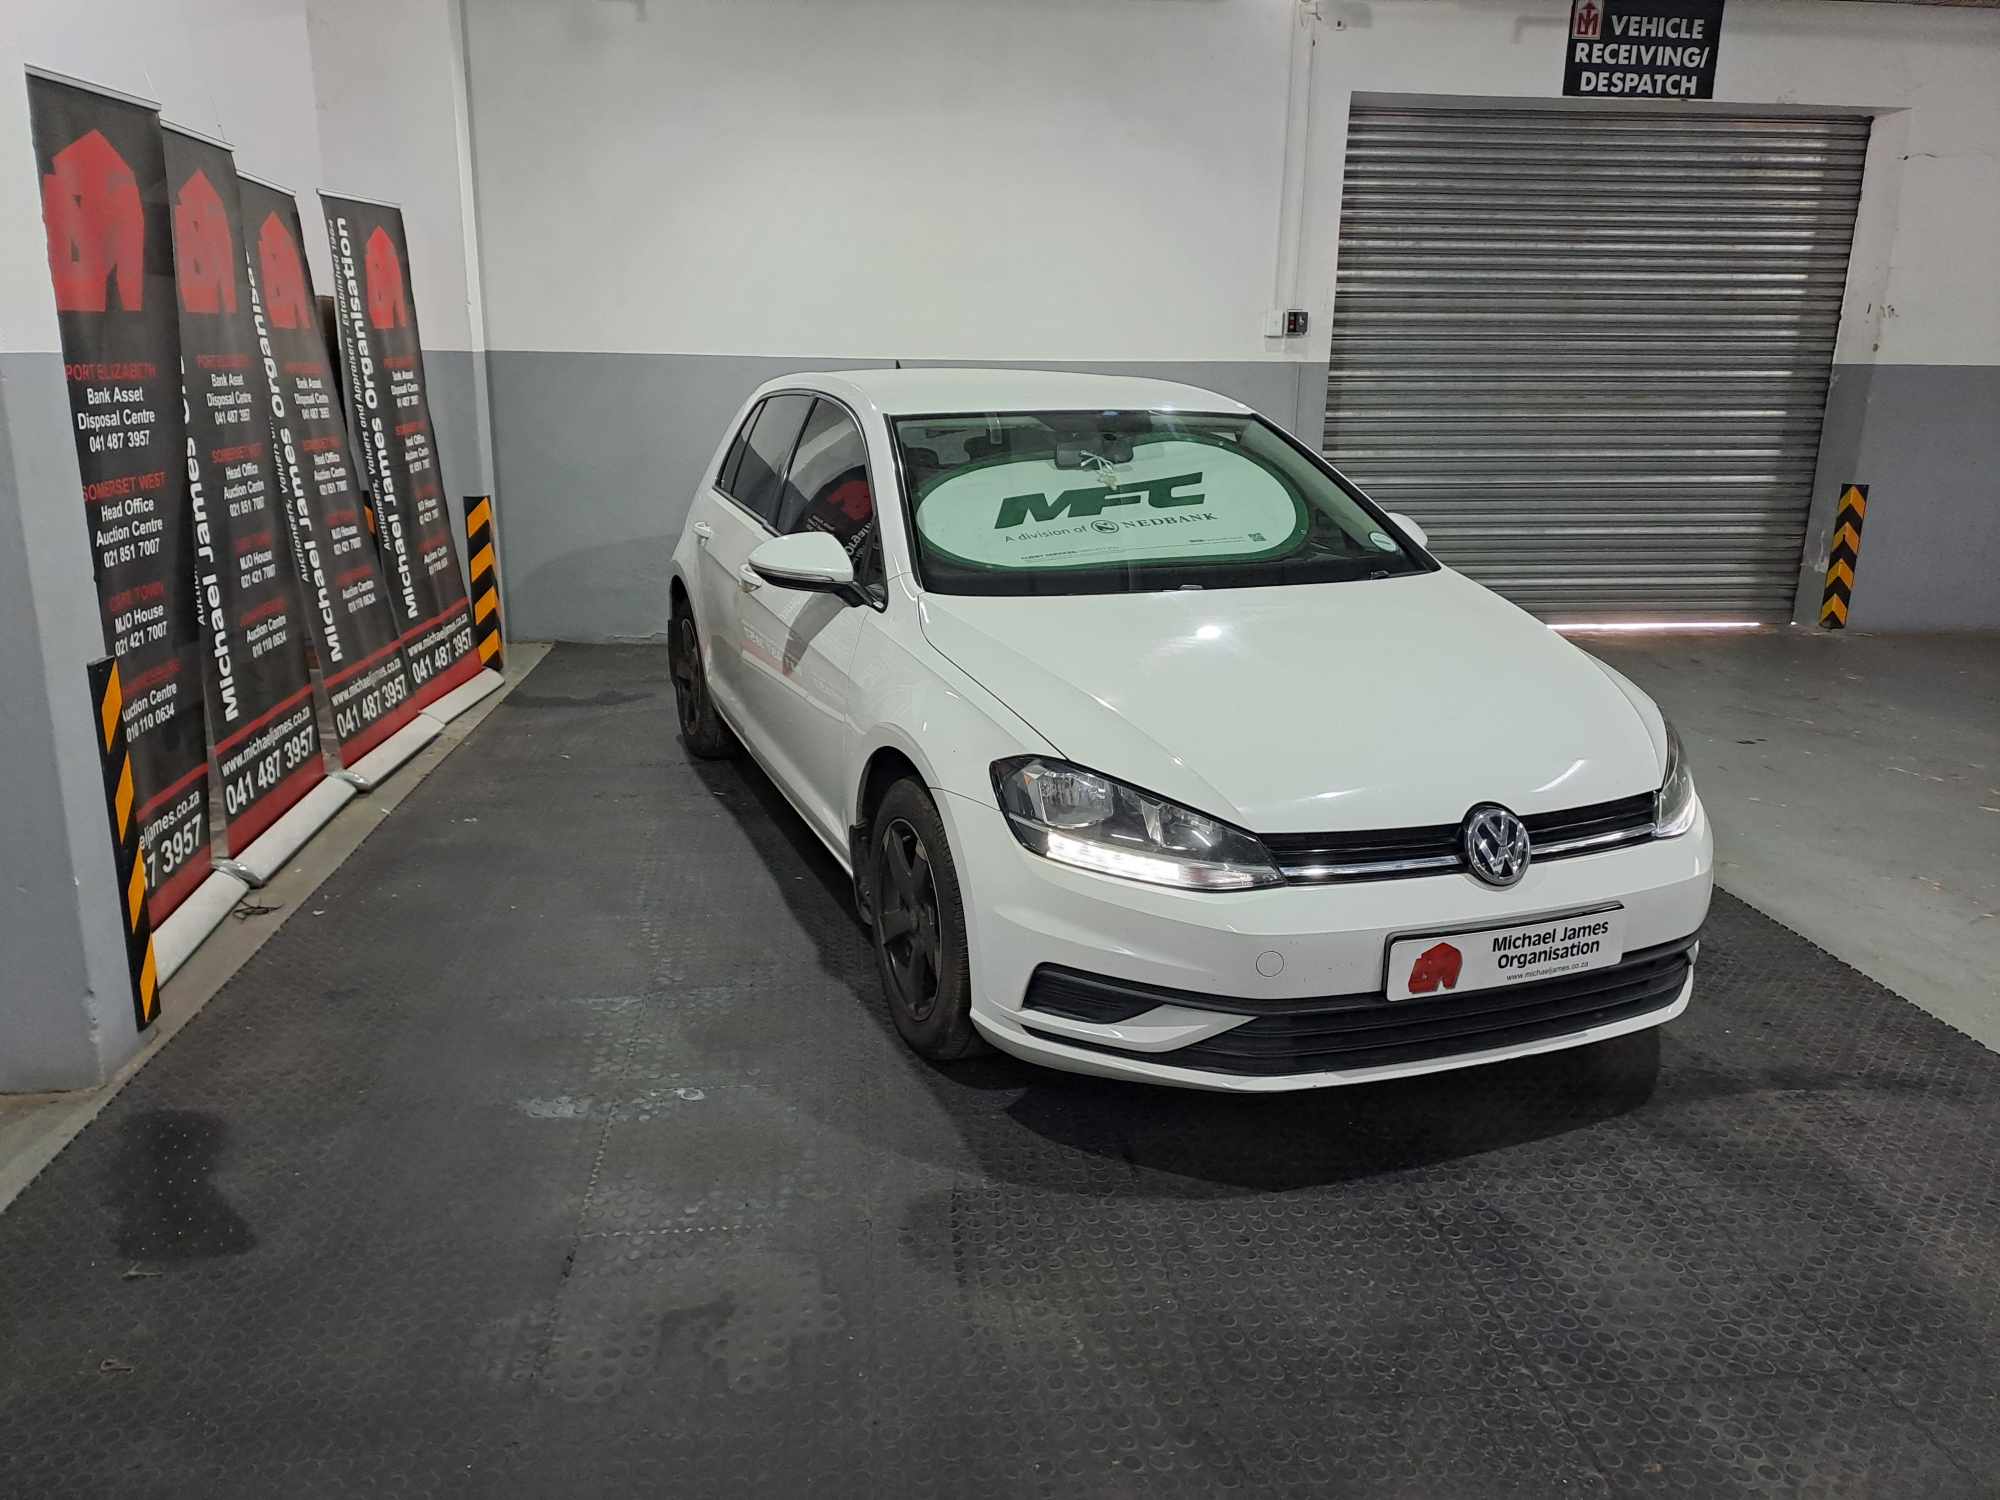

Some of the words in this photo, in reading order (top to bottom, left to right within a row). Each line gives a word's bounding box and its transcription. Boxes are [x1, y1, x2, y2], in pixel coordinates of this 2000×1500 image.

[1611, 15, 1705, 40] VEHICLE
[1574, 42, 1710, 69] RECEIVING/
[1579, 71, 1697, 96] DESPATCH
[337, 217, 378, 409] Organisation
[86, 387, 111, 405] Bank
[113, 386, 144, 403] Asset
[77, 410, 120, 432] Disposal
[123, 409, 155, 425] Centre
[355, 404, 368, 429] and
[89, 436, 105, 453] 041
[107, 432, 124, 450] 487
[127, 430, 150, 448] 3957
[362, 431, 376, 475] Valuers
[371, 417, 398, 507] James
[280, 427, 313, 532] James
[101, 500, 122, 522] Head
[125, 497, 154, 516] Office
[187, 437, 214, 563] James
[994, 471, 1206, 530] MFC
[96, 525, 130, 547] Auction
[132, 518, 163, 537] Centre
[1004, 535, 1015, 545] A
[1018, 527, 1070, 541] division
[1071, 524, 1087, 535] of
[1121, 512, 1218, 529] NEDBANK
[104, 549, 118, 568] 021
[120, 544, 135, 562] 851
[138, 538, 160, 557] 7007
[388, 514, 419, 620] Michael
[304, 541, 343, 663] Michael
[115, 615, 133, 634] MJO
[133, 604, 164, 626] House
[115, 637, 129, 657] 021
[129, 629, 145, 649] 421
[147, 621, 168, 642] 7007
[202, 574, 239, 722] Michael
[412, 654, 433, 684] 041
[434, 643, 453, 669] 487
[453, 627, 473, 656] 3957
[149, 682, 177, 706] Centre
[336, 703, 361, 739] 041
[362, 690, 383, 721] 487
[382, 674, 408, 709] 3957
[226, 770, 255, 815] 041
[257, 750, 281, 789] 487
[284, 725, 314, 769] 3957
[161, 813, 201, 873] 3957
[1492, 928, 1557, 952] Michael
[1560, 920, 1609, 943] James
[1497, 940, 1600, 970] Organisation
